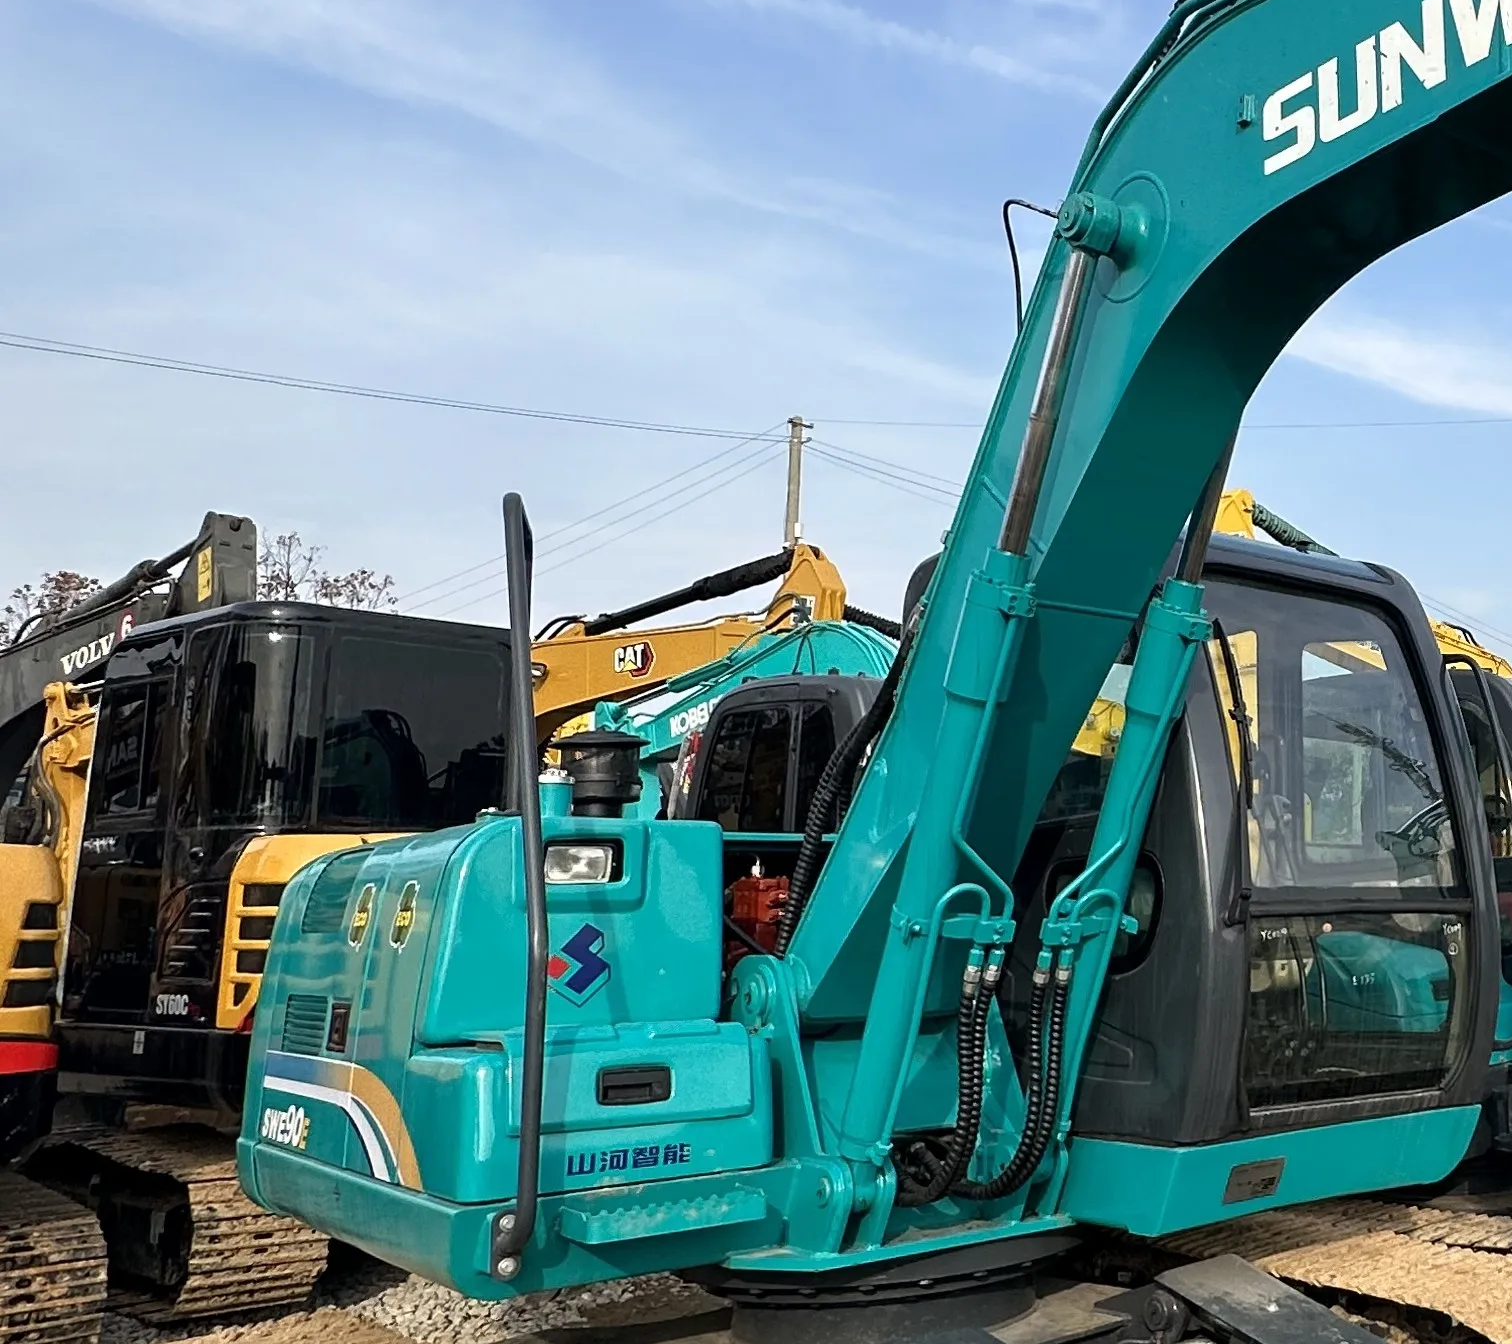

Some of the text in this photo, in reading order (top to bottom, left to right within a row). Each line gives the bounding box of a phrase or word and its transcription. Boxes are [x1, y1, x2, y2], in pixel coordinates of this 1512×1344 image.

[615, 643, 645, 673] CAT
[261, 1104, 312, 1150] SWE90E
[566, 1142, 692, 1176] 山河智能
